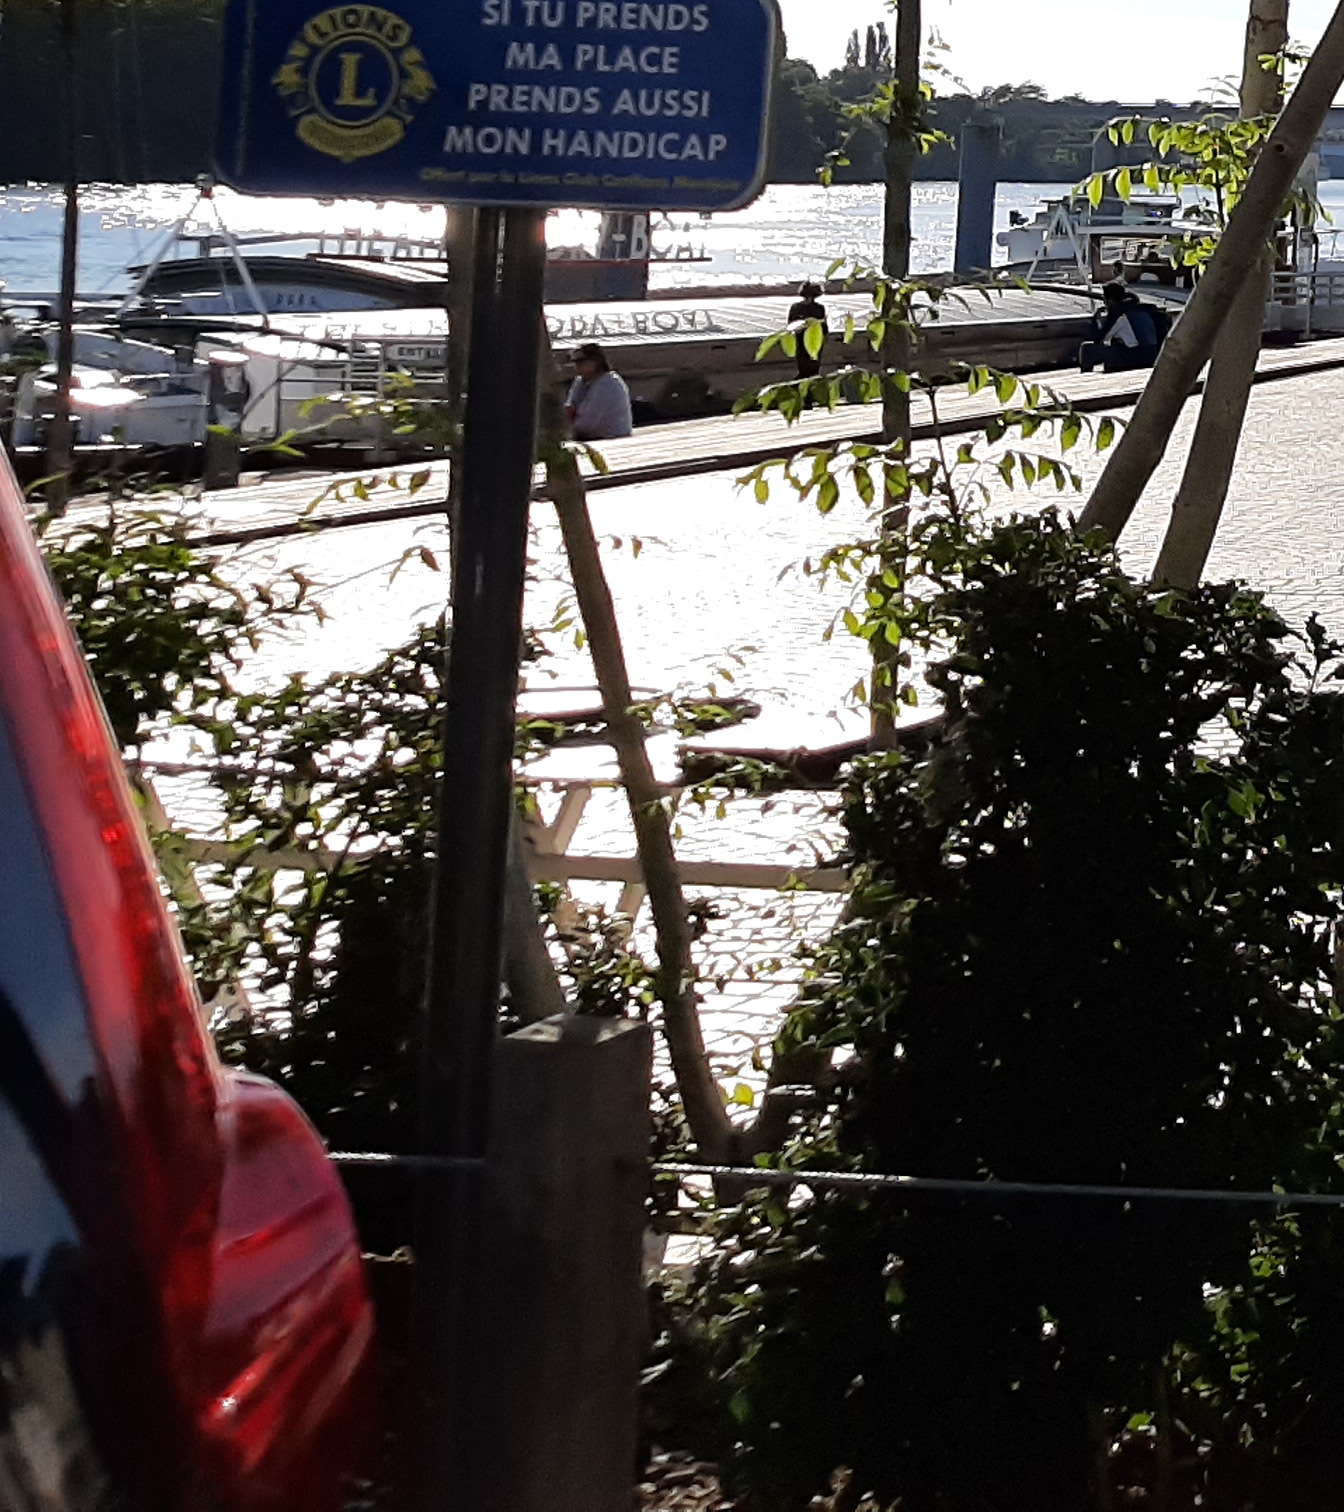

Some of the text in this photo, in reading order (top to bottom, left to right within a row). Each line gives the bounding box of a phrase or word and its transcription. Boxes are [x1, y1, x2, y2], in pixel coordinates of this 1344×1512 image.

[312, 8, 405, 36] LIONS
[481, 0, 710, 32] SI TU PRENDS
[505, 41, 680, 74] MA PLACE
[335, 52, 377, 105] L
[467, 83, 710, 118] PRENDS AUSSI
[443, 126, 727, 161] MON HANDICAP
